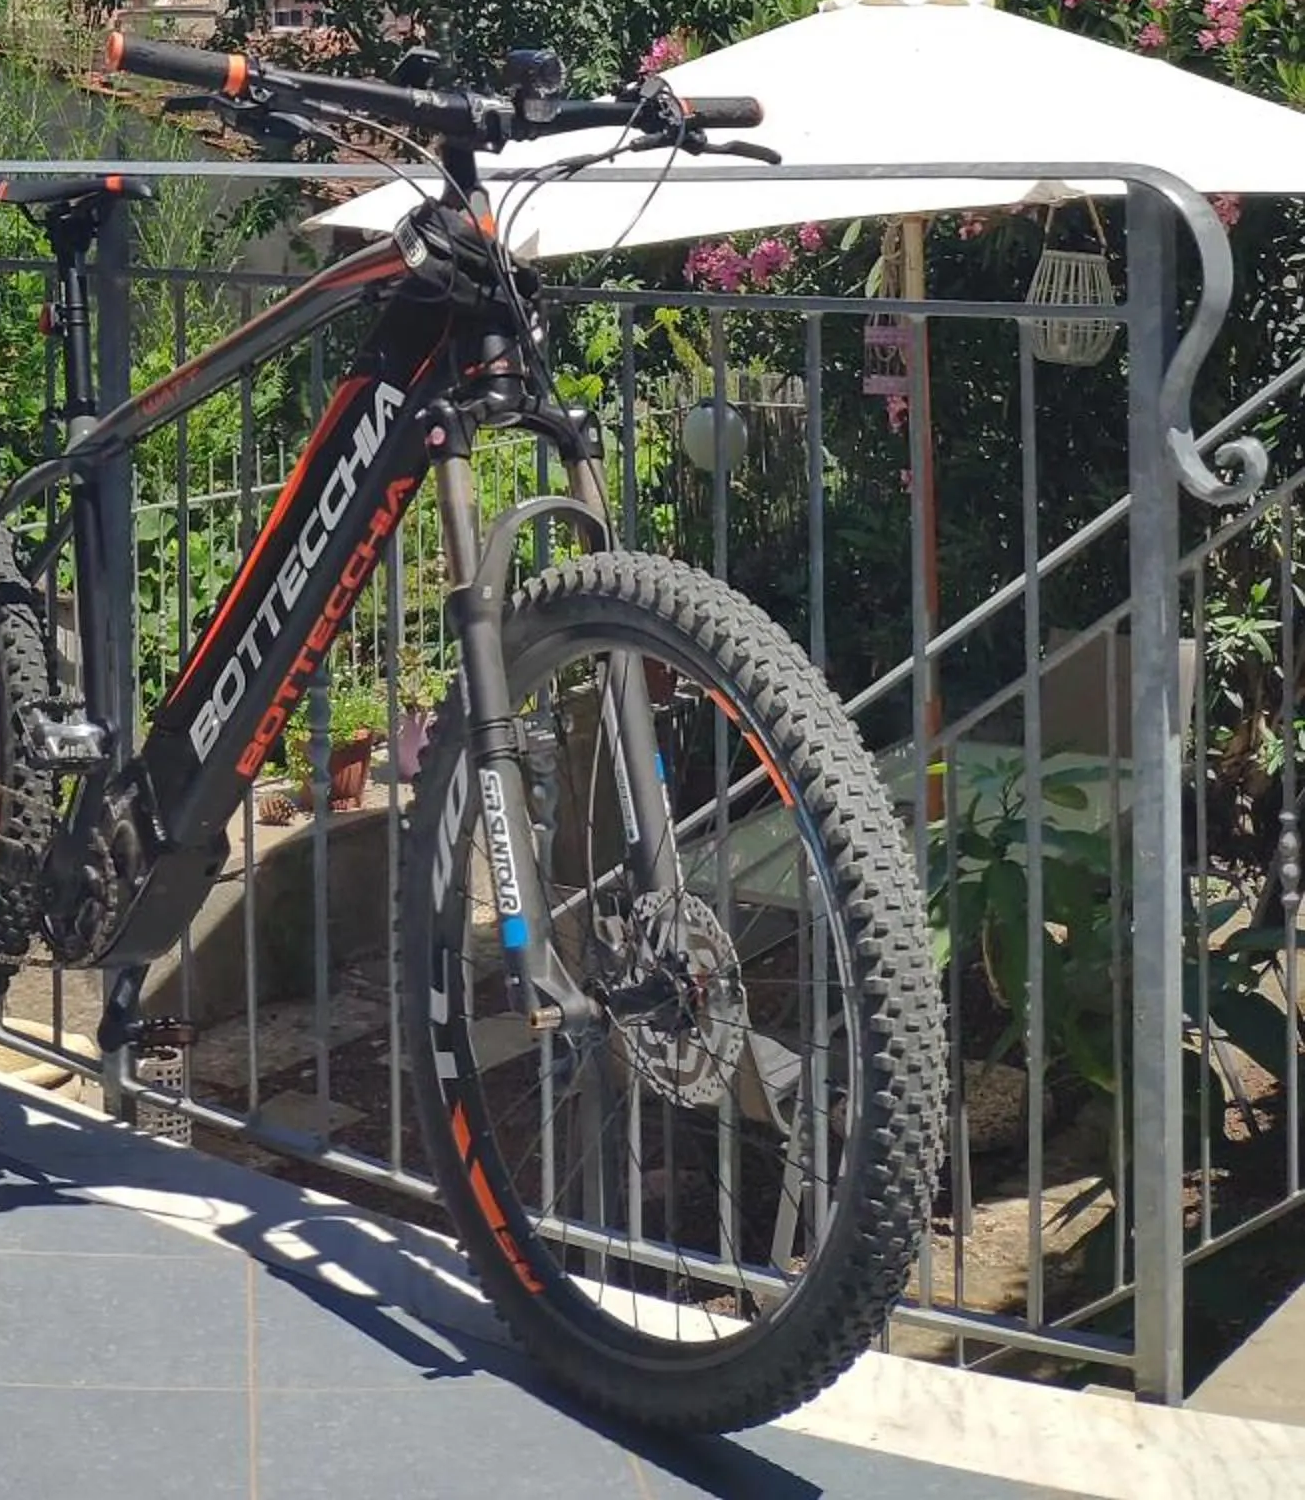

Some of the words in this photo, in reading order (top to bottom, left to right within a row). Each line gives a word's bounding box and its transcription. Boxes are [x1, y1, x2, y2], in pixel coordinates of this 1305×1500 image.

[188, 381, 406, 764] BOTTECCHIA
[235, 477, 415, 779] BOTTECCHIA
[490, 816, 521, 913] SUNTOUR
